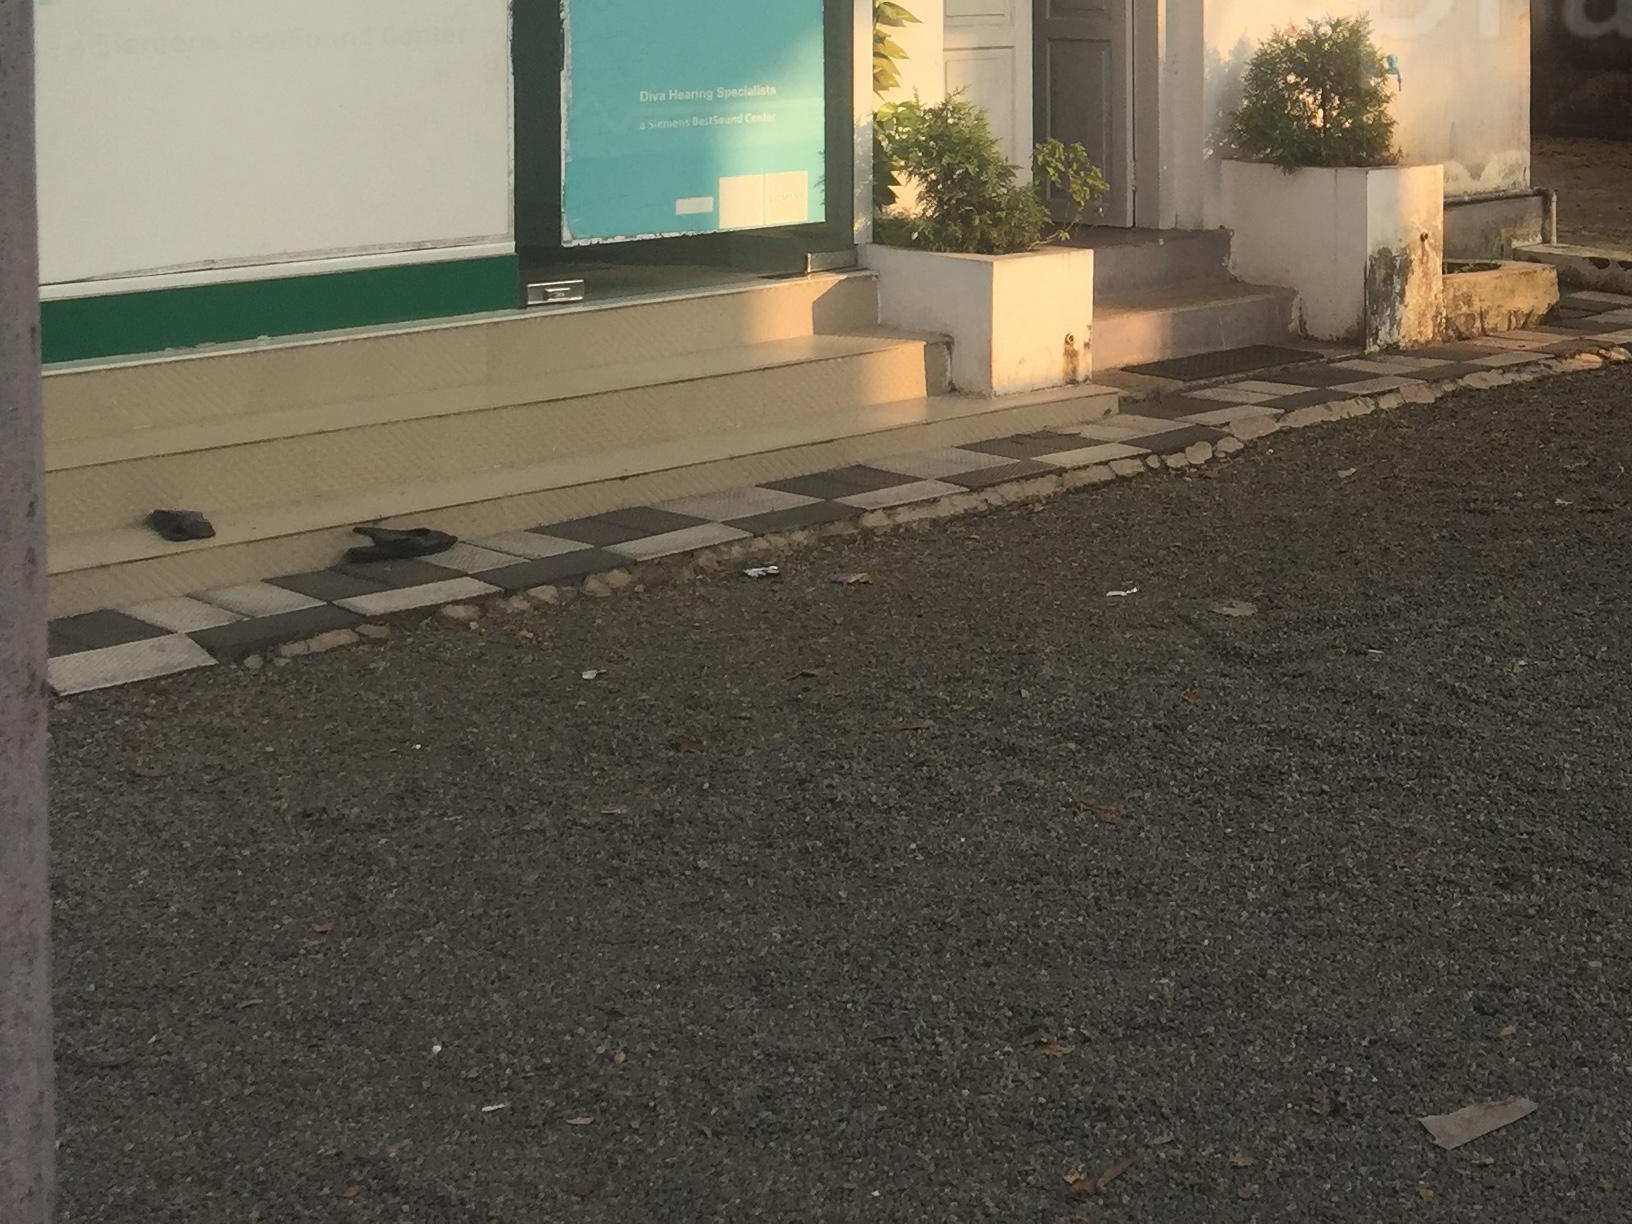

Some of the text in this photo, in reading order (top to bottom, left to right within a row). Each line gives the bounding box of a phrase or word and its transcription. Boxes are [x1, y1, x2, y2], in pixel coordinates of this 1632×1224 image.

[640, 85, 777, 103] Diva Hearing Specialists
